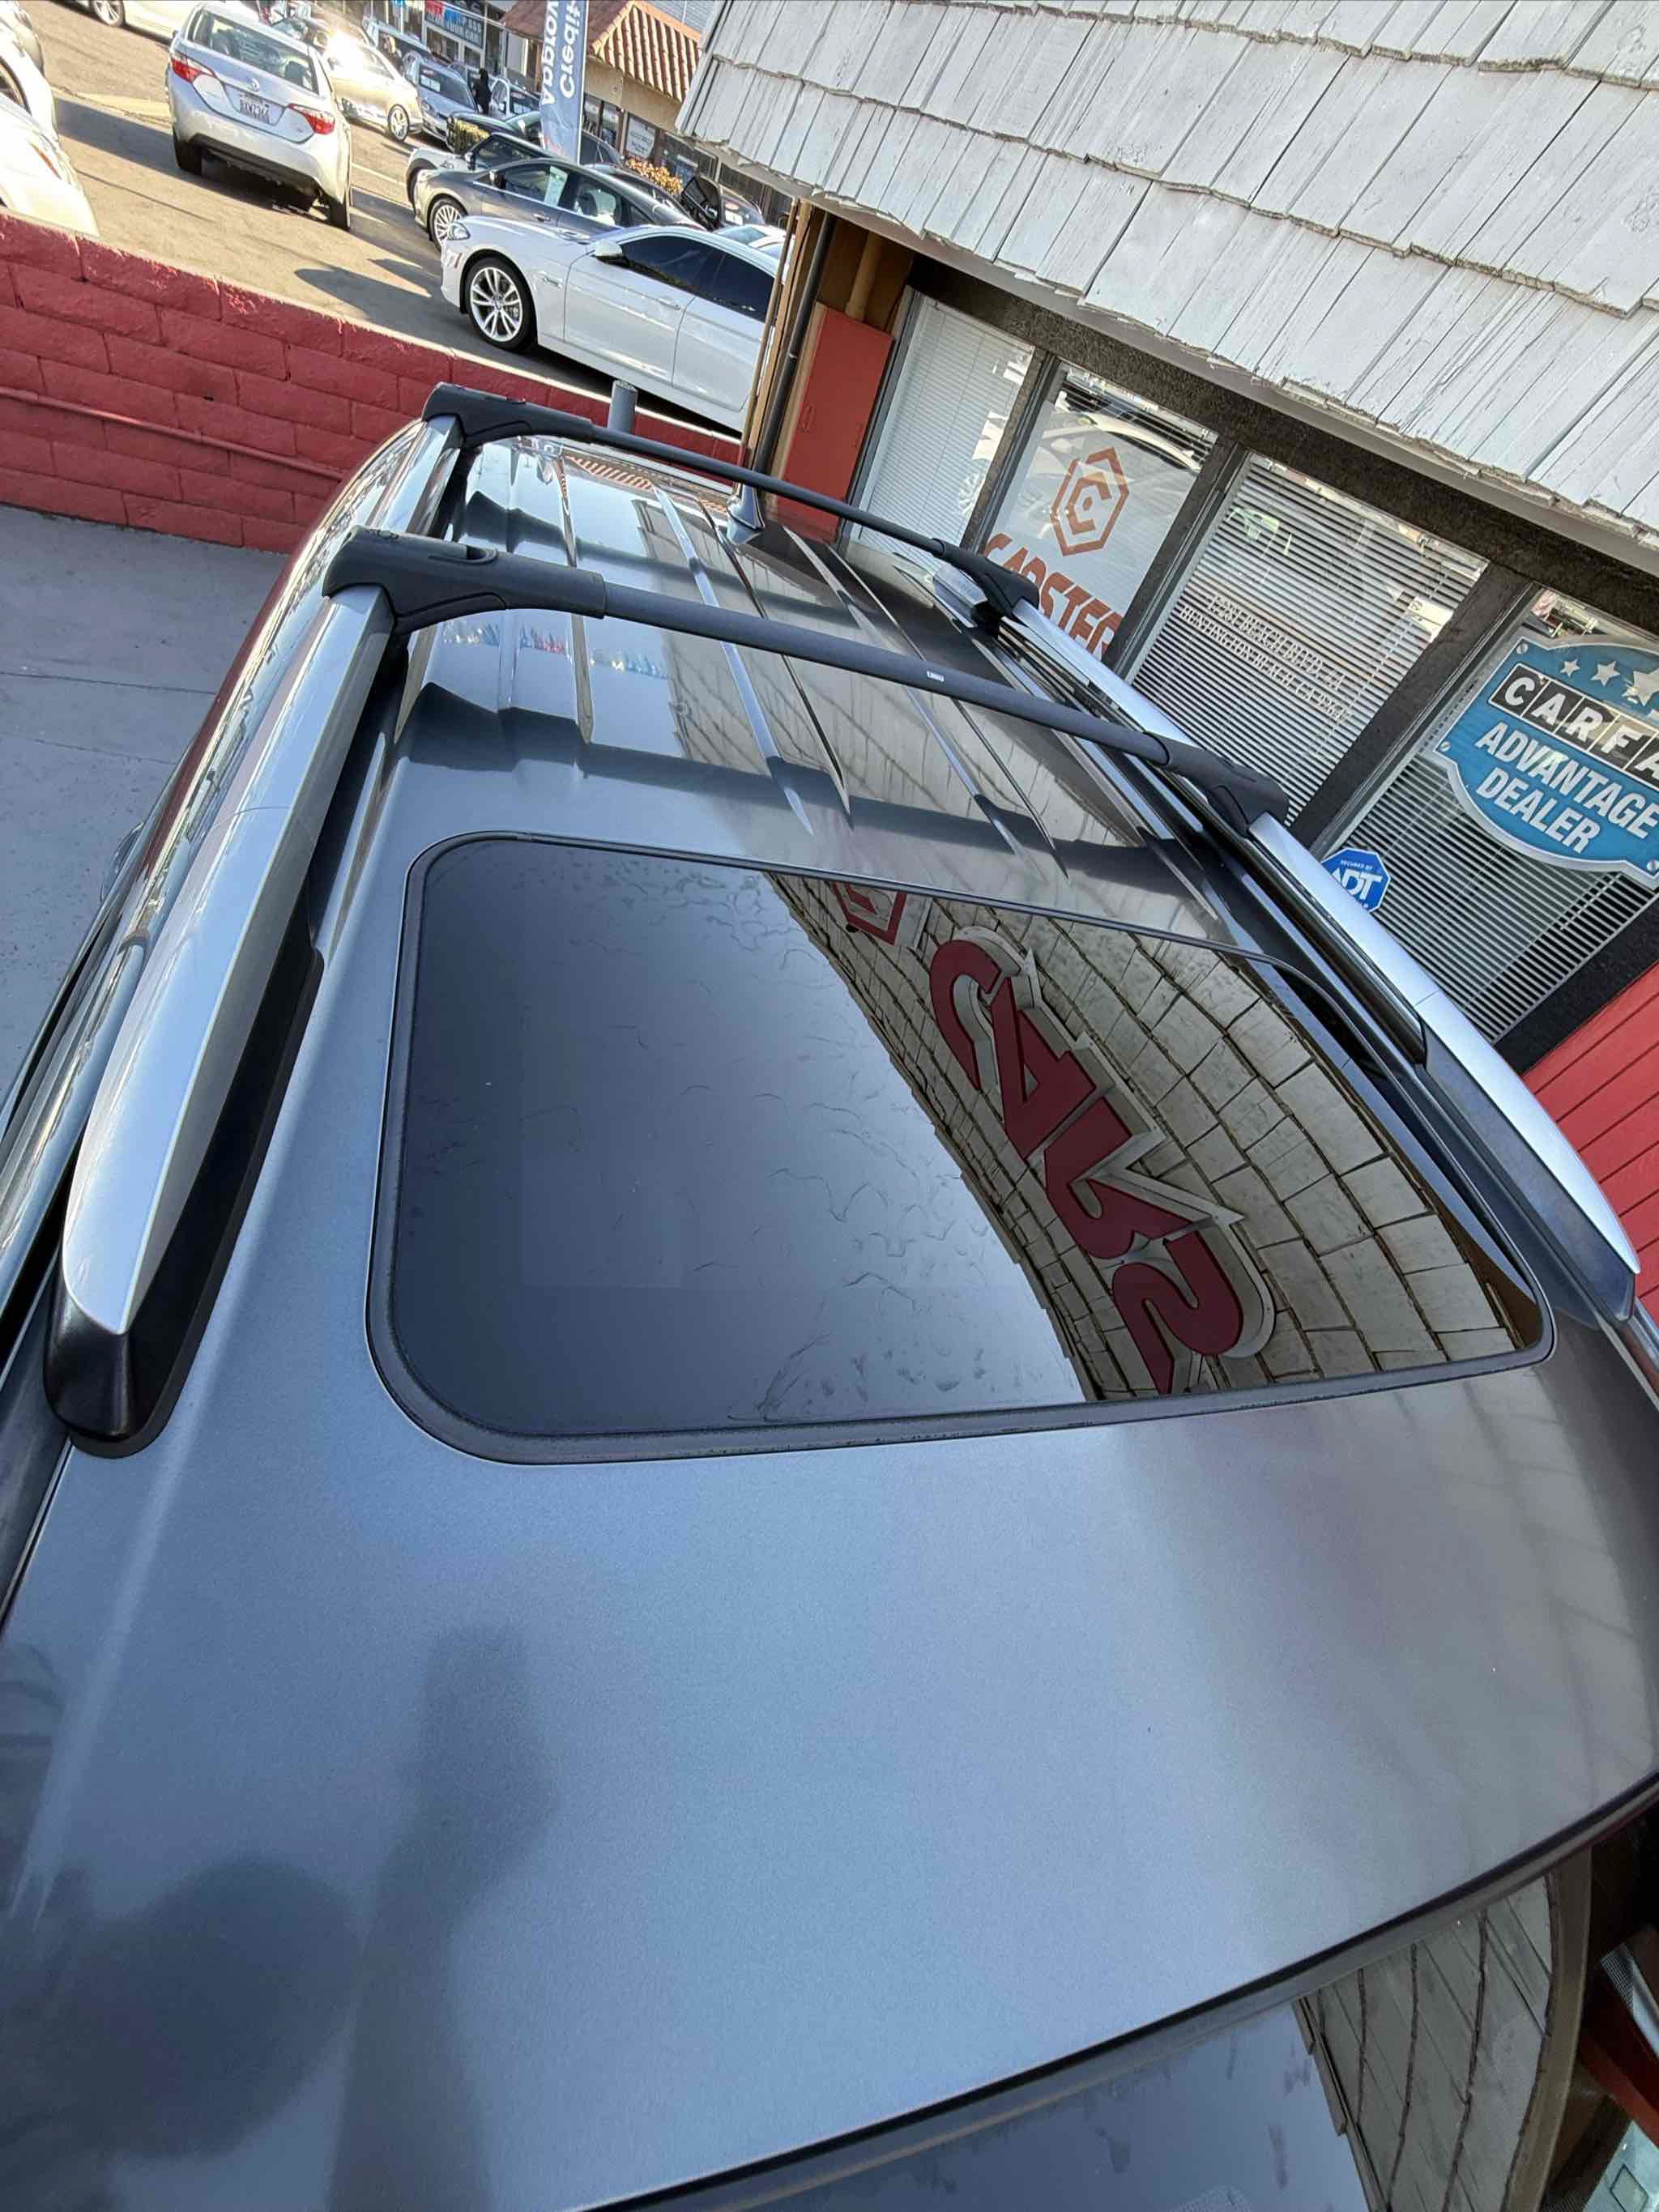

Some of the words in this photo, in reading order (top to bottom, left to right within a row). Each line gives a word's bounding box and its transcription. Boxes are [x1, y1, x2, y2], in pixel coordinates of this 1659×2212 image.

[1179, 604, 1253, 659] HUNTINGTON
[1296, 683, 1316, 702] CA
[1239, 615, 1287, 652] BEACH
[1504, 677, 1659, 780] CARFA
[1474, 722, 1659, 839] ADVANTAGE
[1476, 767, 1601, 854] DEALER
